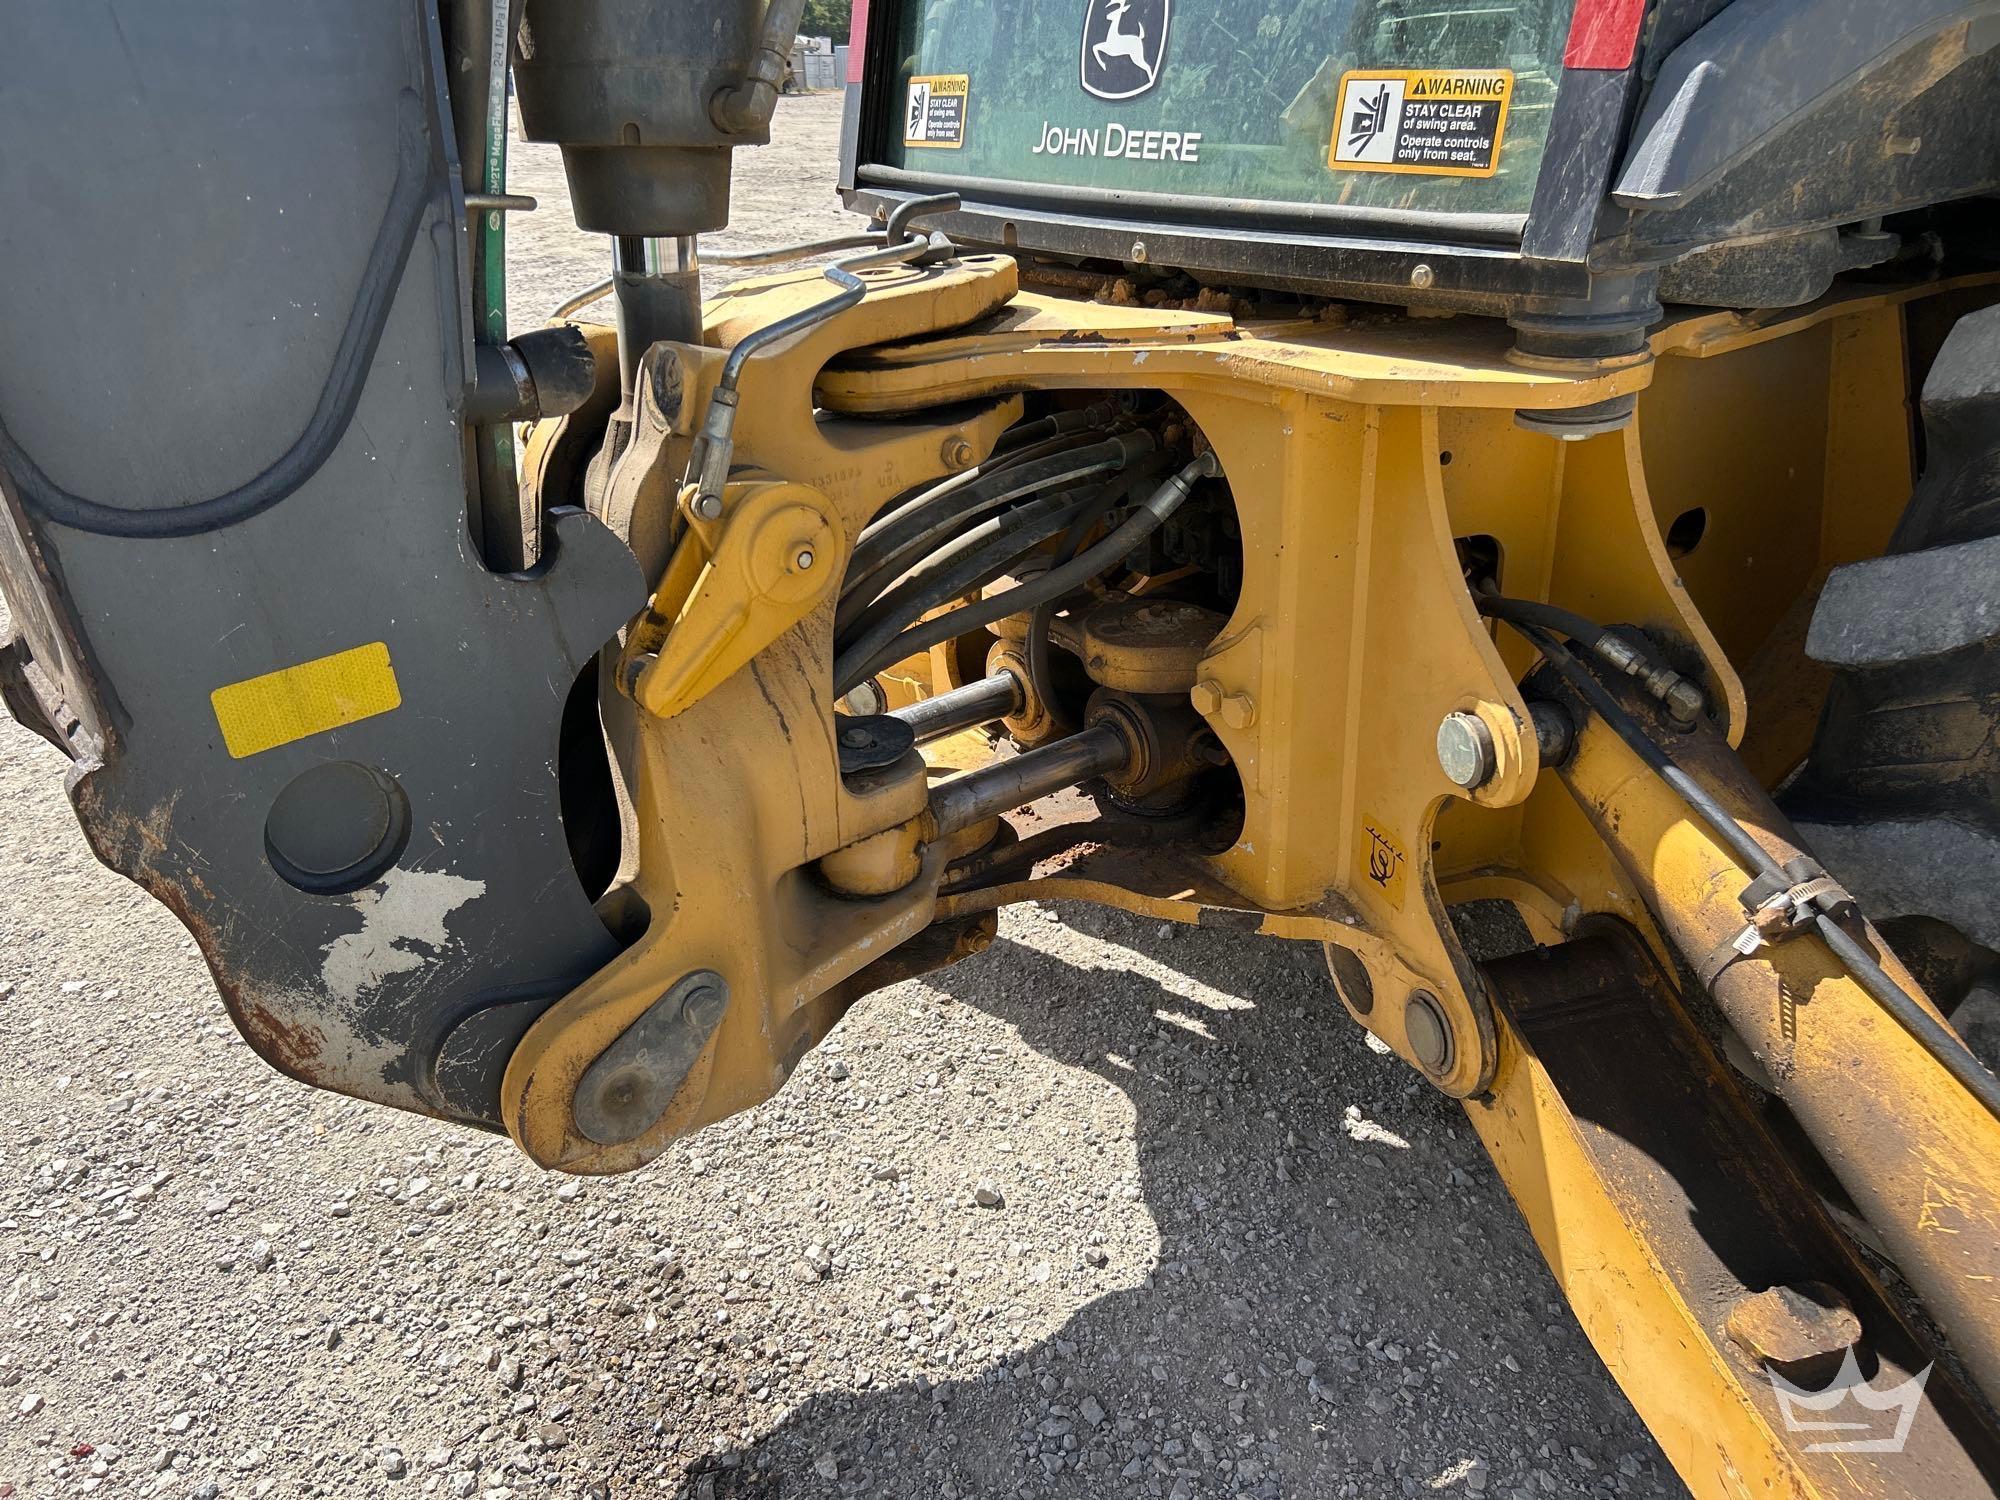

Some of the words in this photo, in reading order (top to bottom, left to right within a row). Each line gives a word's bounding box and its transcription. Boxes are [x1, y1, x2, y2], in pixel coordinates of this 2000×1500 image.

[938, 80, 966, 92] WARNING
[1428, 78, 1505, 96] WARNING
[930, 98, 942, 108] STAY
[942, 98, 958, 108] CLEAR
[1405, 103, 1437, 118] STAY
[1439, 104, 1482, 118] CLEAR
[1403, 118, 1415, 129] of
[1416, 119, 1447, 133] swing
[1450, 121, 1477, 131] area.
[1032, 121, 1099, 156] JOHN
[1103, 123, 1202, 162] DEERE
[1400, 135, 1441, 149] Operate
[1443, 137, 1490, 149] controls
[1398, 149, 1421, 162] only
[1423, 149, 1448, 161] from
[1450, 151, 1477, 162] seat.
